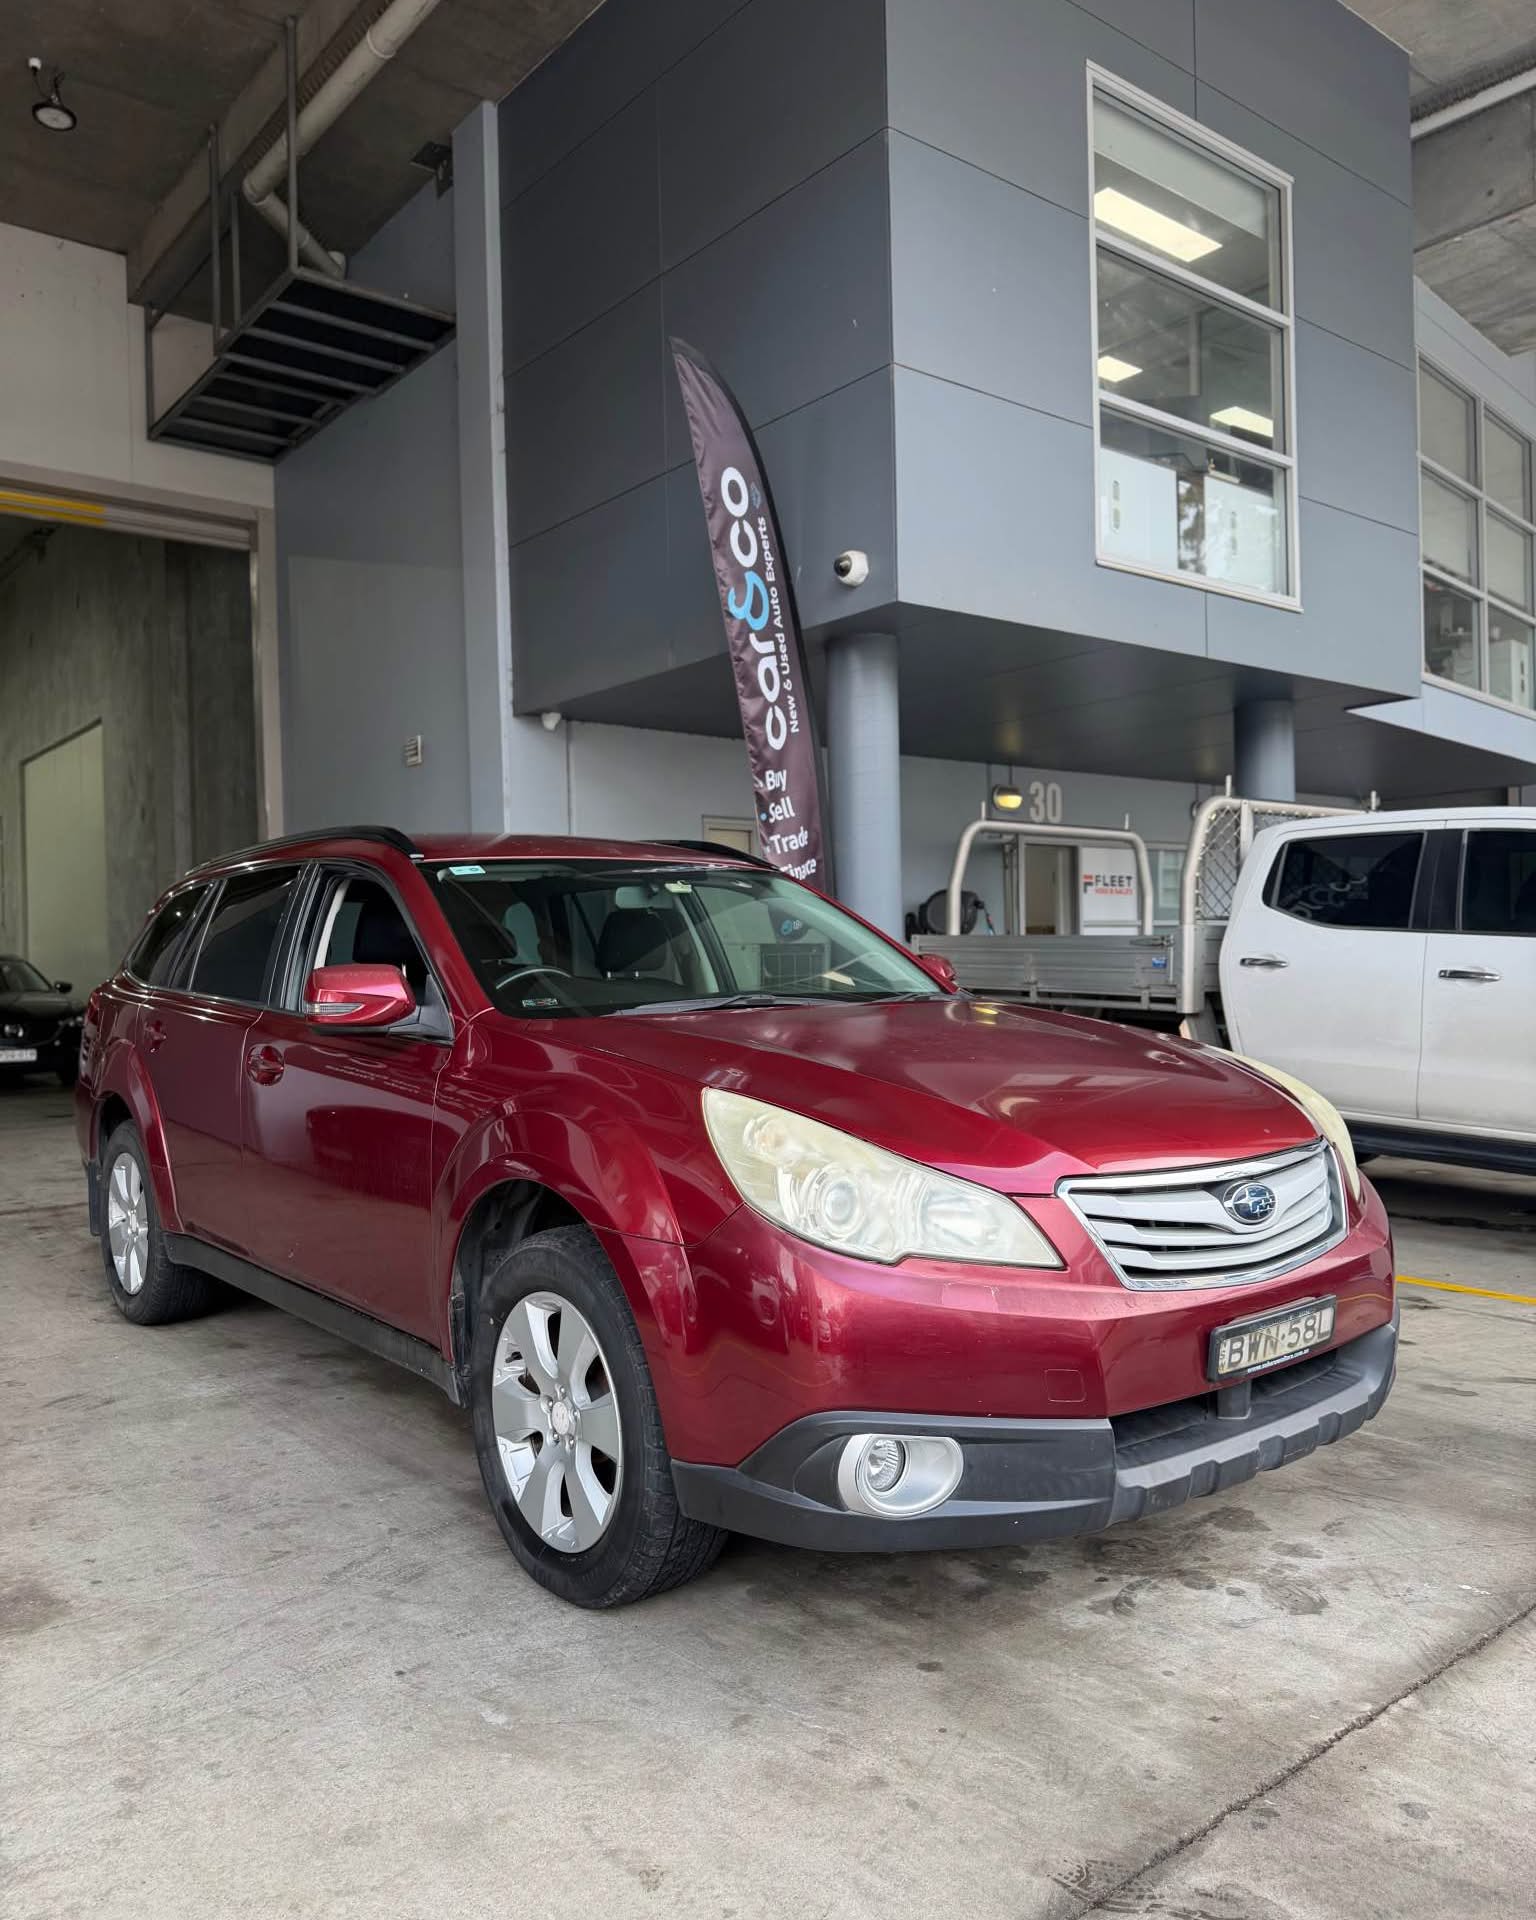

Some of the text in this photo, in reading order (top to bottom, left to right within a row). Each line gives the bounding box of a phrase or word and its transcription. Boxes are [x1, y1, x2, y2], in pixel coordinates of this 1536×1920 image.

[721, 466, 787, 750] car&co
[757, 516, 799, 733] New & Used Auto Experts
[765, 769, 787, 792] Buy
[768, 796, 795, 823] Sell
[1030, 781, 1062, 823] 30
[769, 826, 808, 855] Trade
[1095, 874, 1133, 887] FLEET
